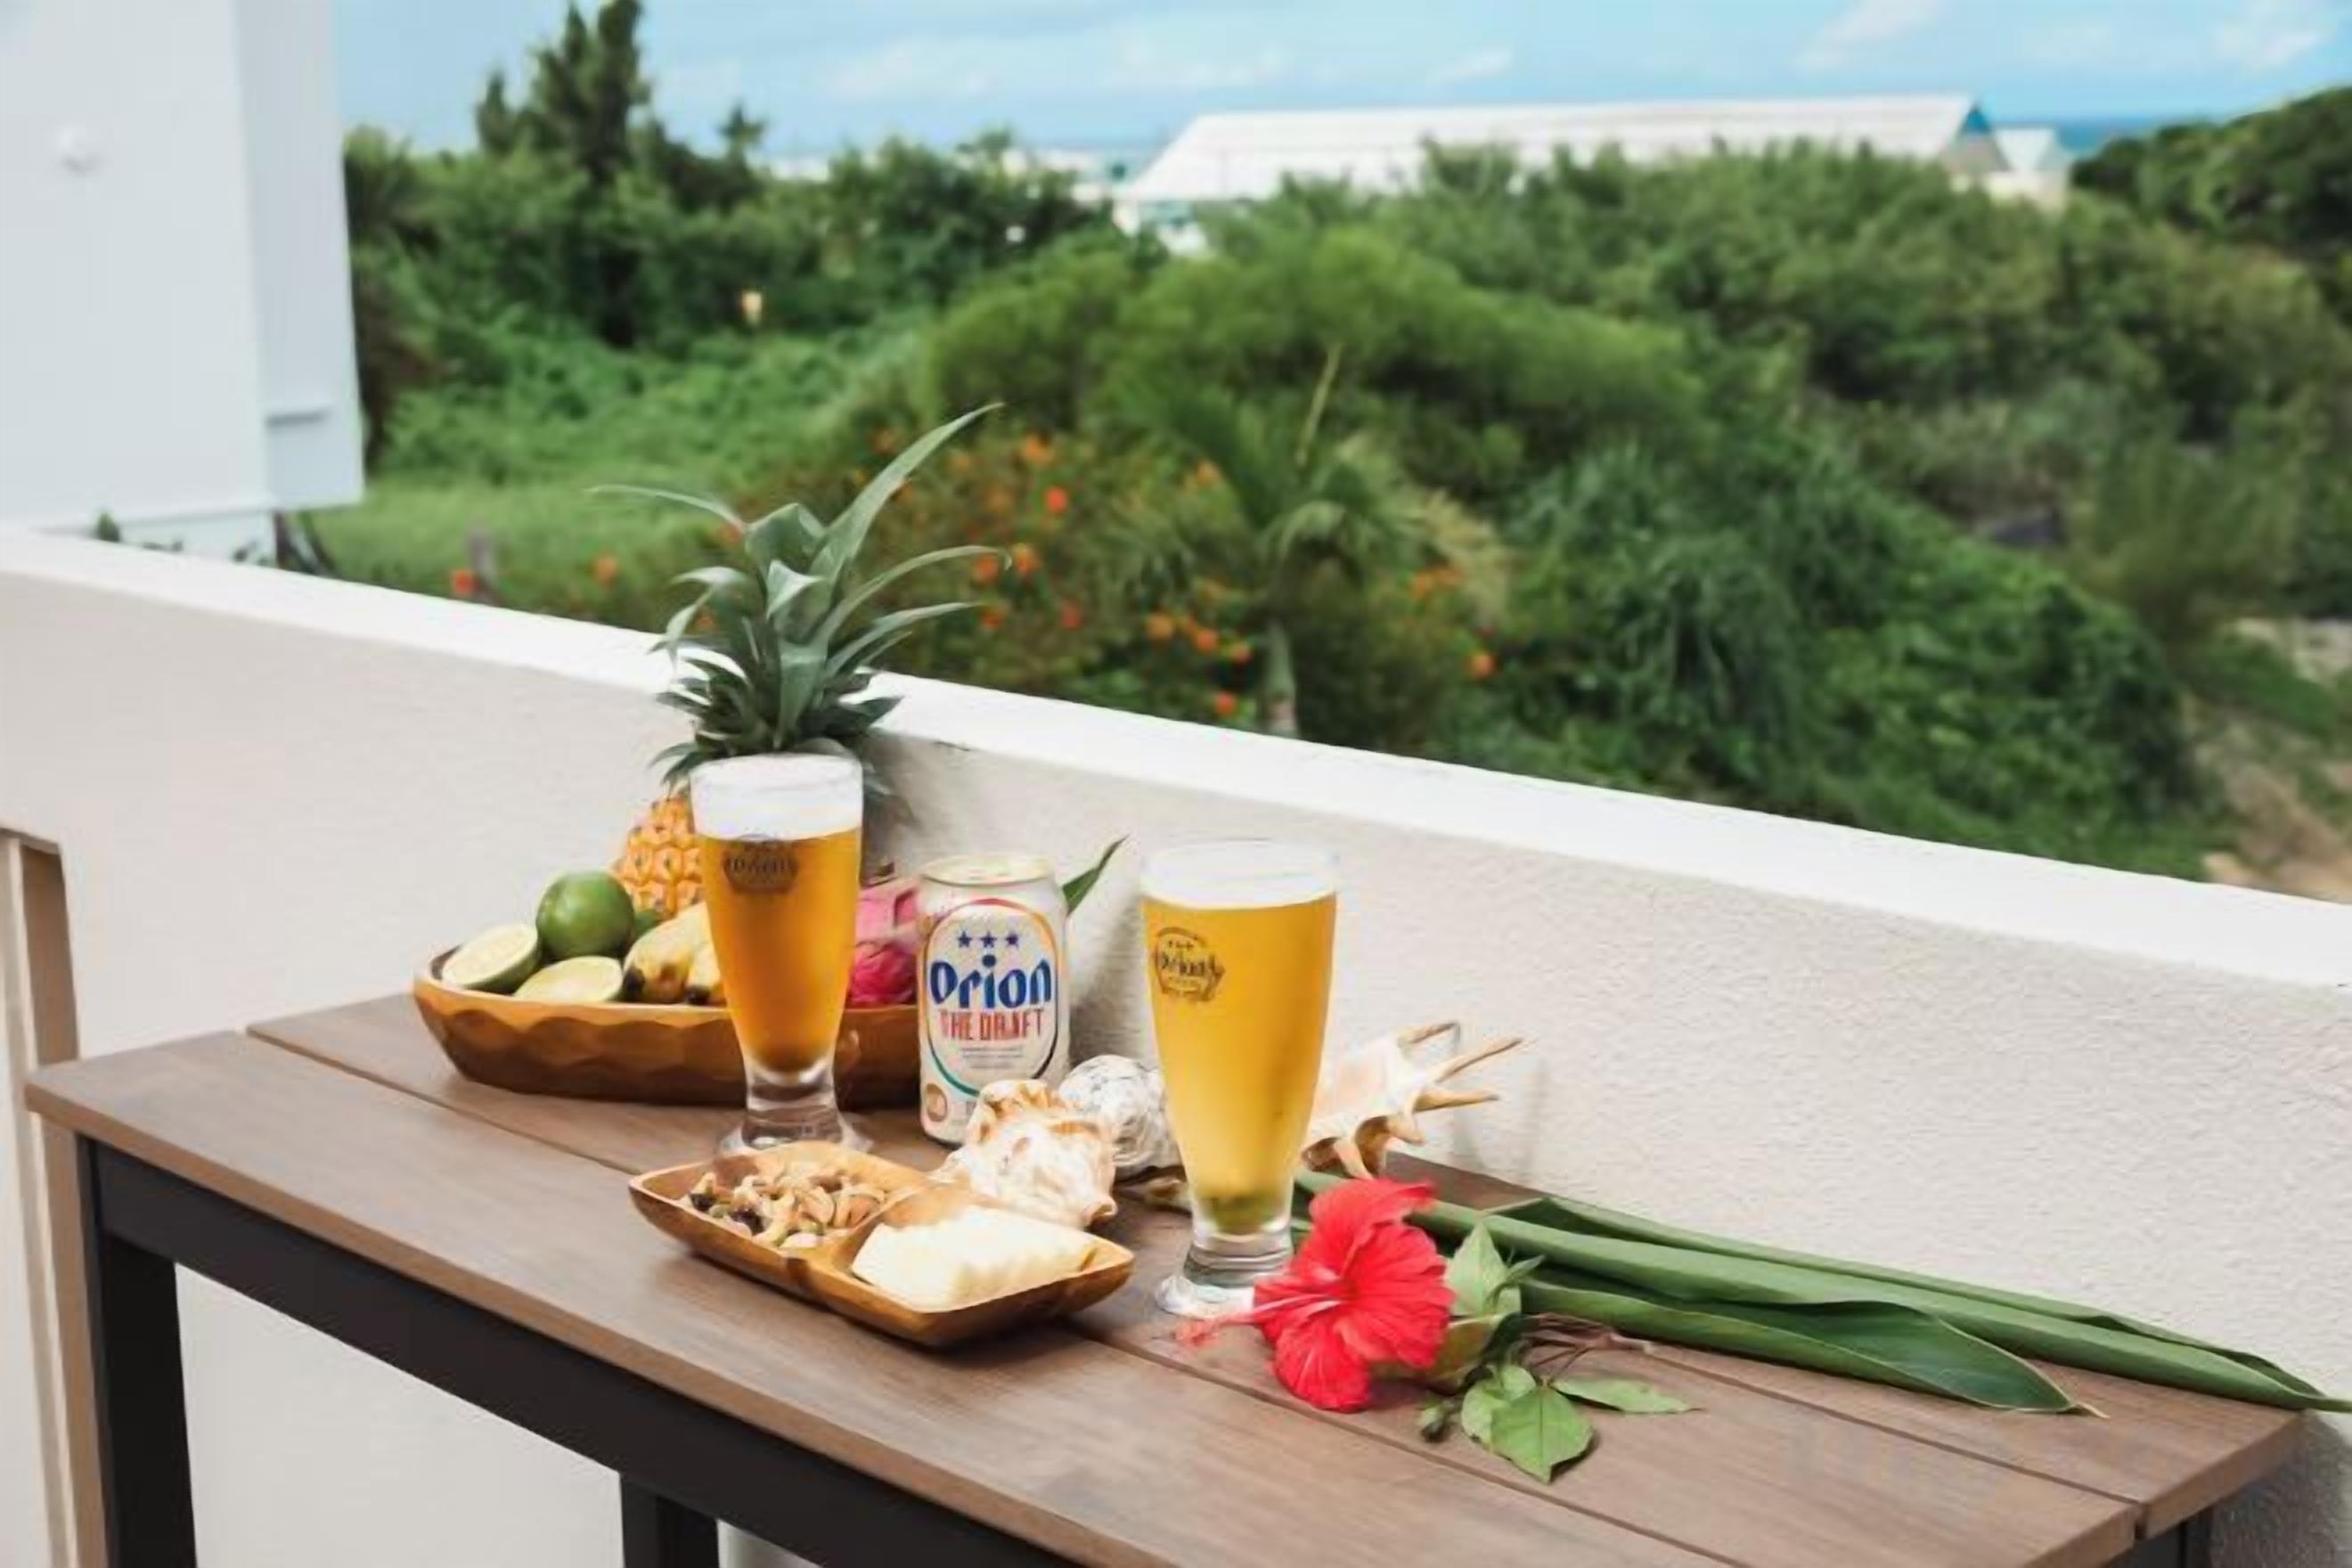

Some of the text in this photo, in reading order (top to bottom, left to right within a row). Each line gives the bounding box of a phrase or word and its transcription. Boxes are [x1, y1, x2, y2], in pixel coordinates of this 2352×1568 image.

[930, 954, 1051, 1009] Orion
[939, 1009, 1045, 1041] THE DRAFT
